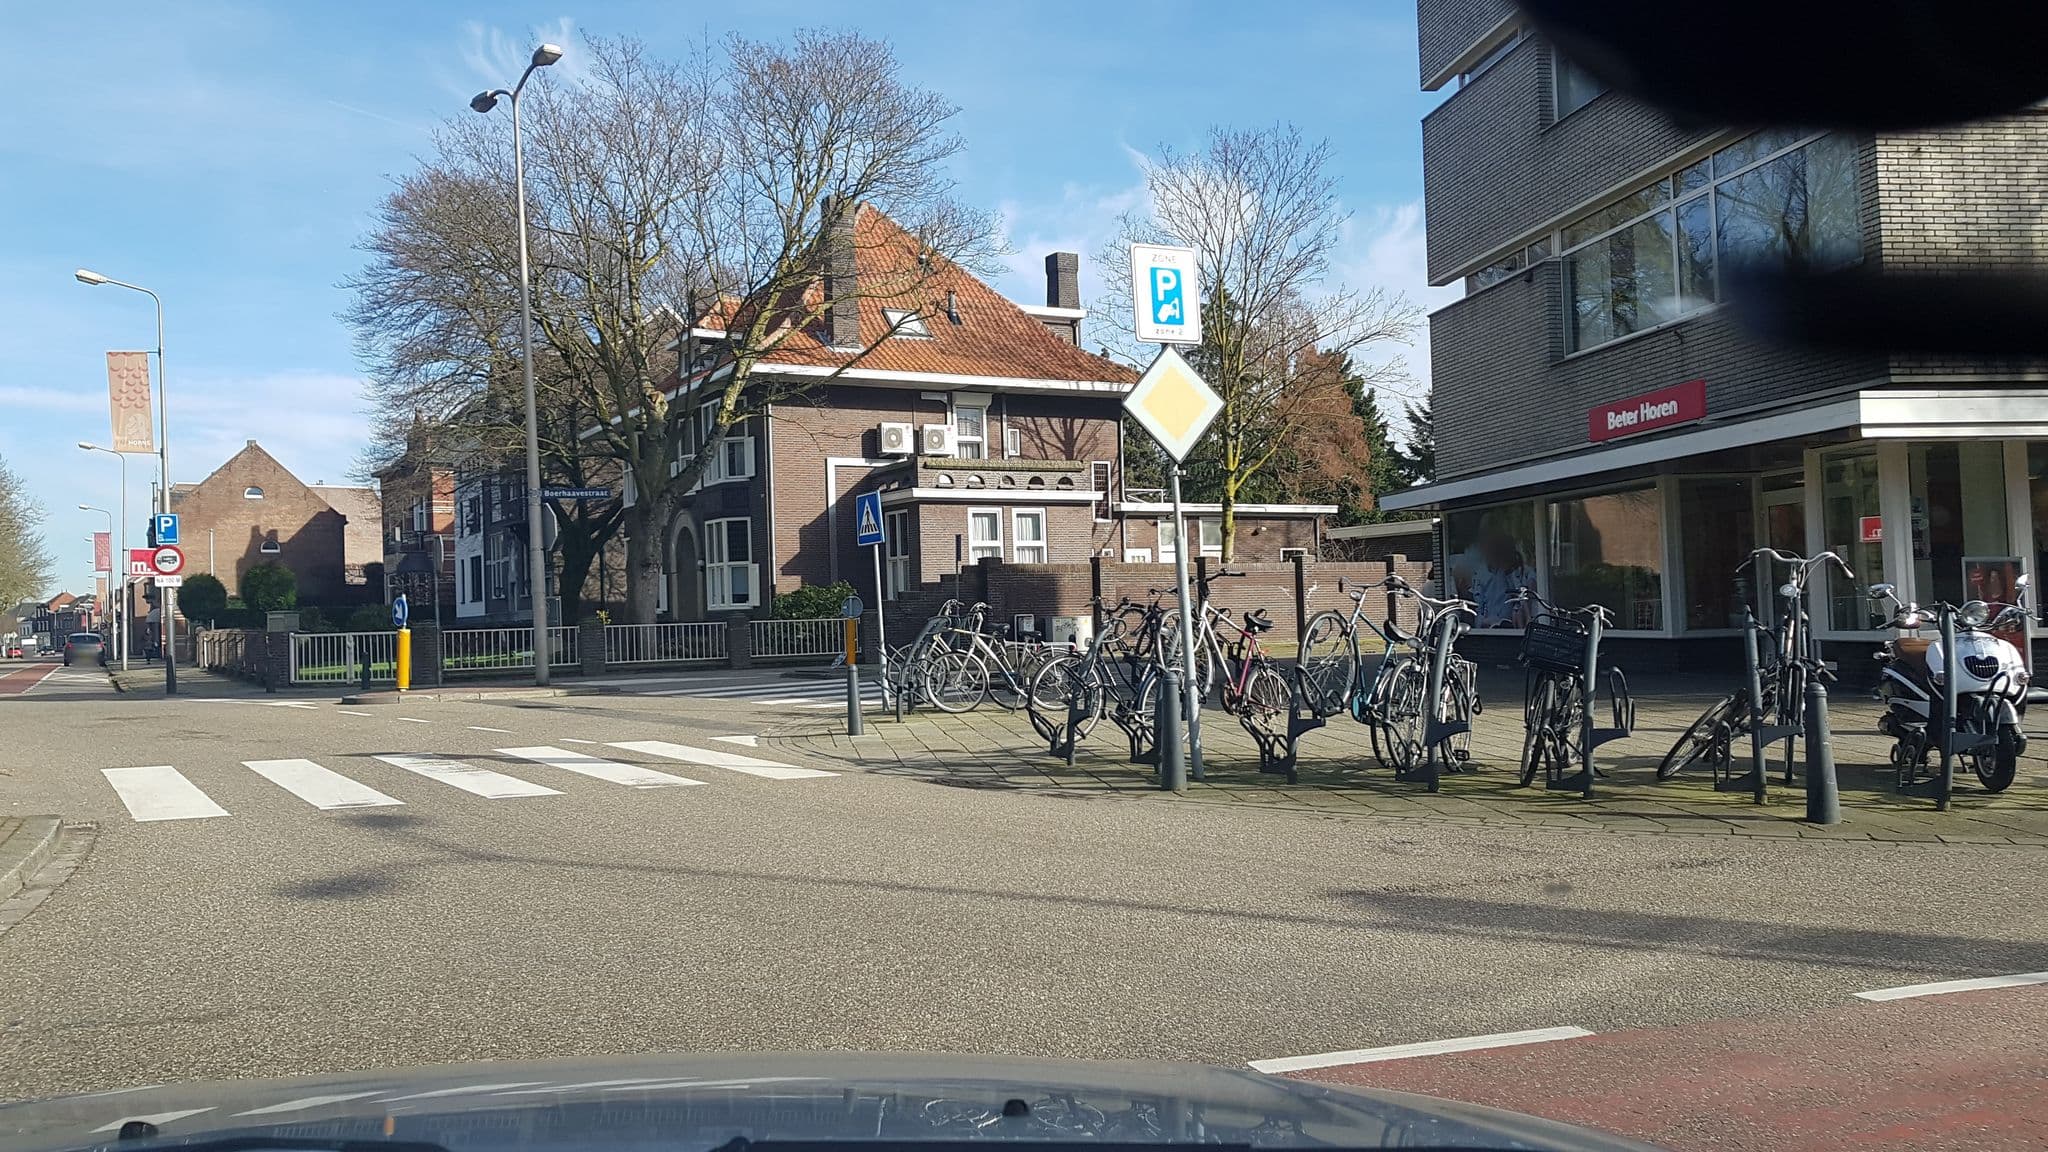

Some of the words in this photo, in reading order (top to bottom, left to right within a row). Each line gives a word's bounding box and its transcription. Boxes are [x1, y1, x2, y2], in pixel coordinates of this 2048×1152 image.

[1156, 269, 1178, 302] P
[1607, 410, 1639, 431] Beter
[1640, 400, 1679, 422] Horen
[160, 517, 173, 533] P
